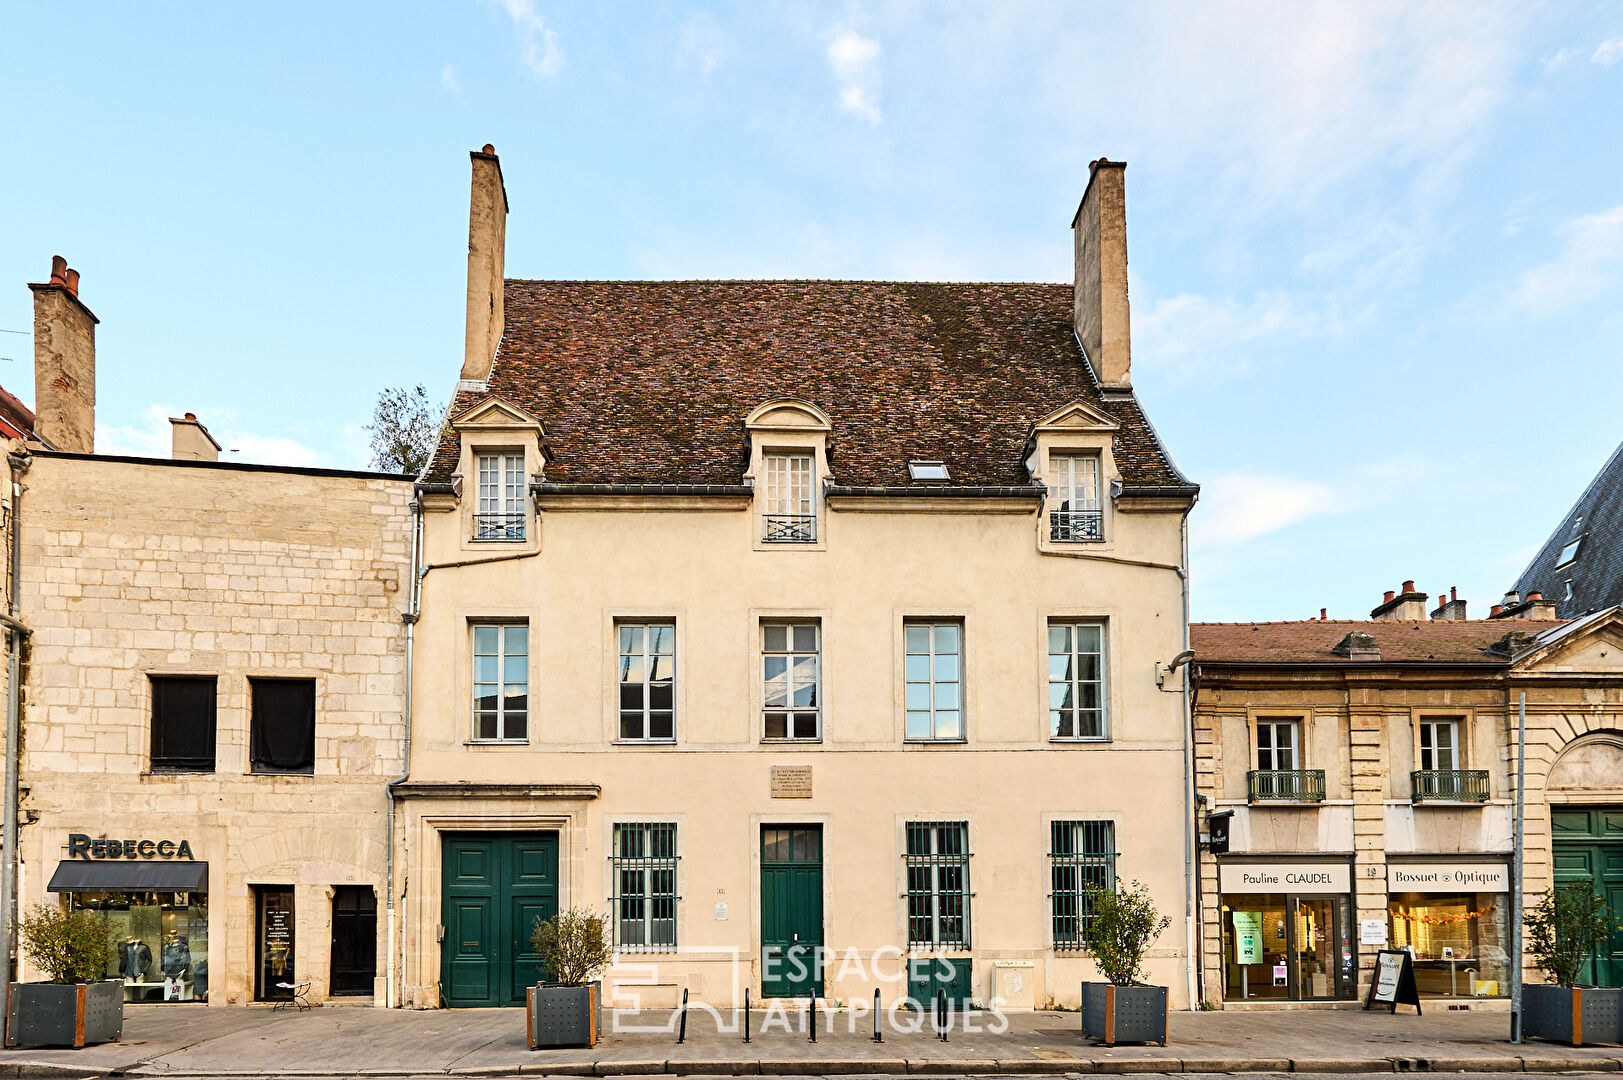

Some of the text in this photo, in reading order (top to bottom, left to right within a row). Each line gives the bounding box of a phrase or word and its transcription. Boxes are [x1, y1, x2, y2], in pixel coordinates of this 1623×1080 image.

[69, 833, 195, 861] REBECCA
[1243, 872, 1333, 884] Pauline CLAUDEL
[1395, 870, 1500, 885] Bossuet Optique
